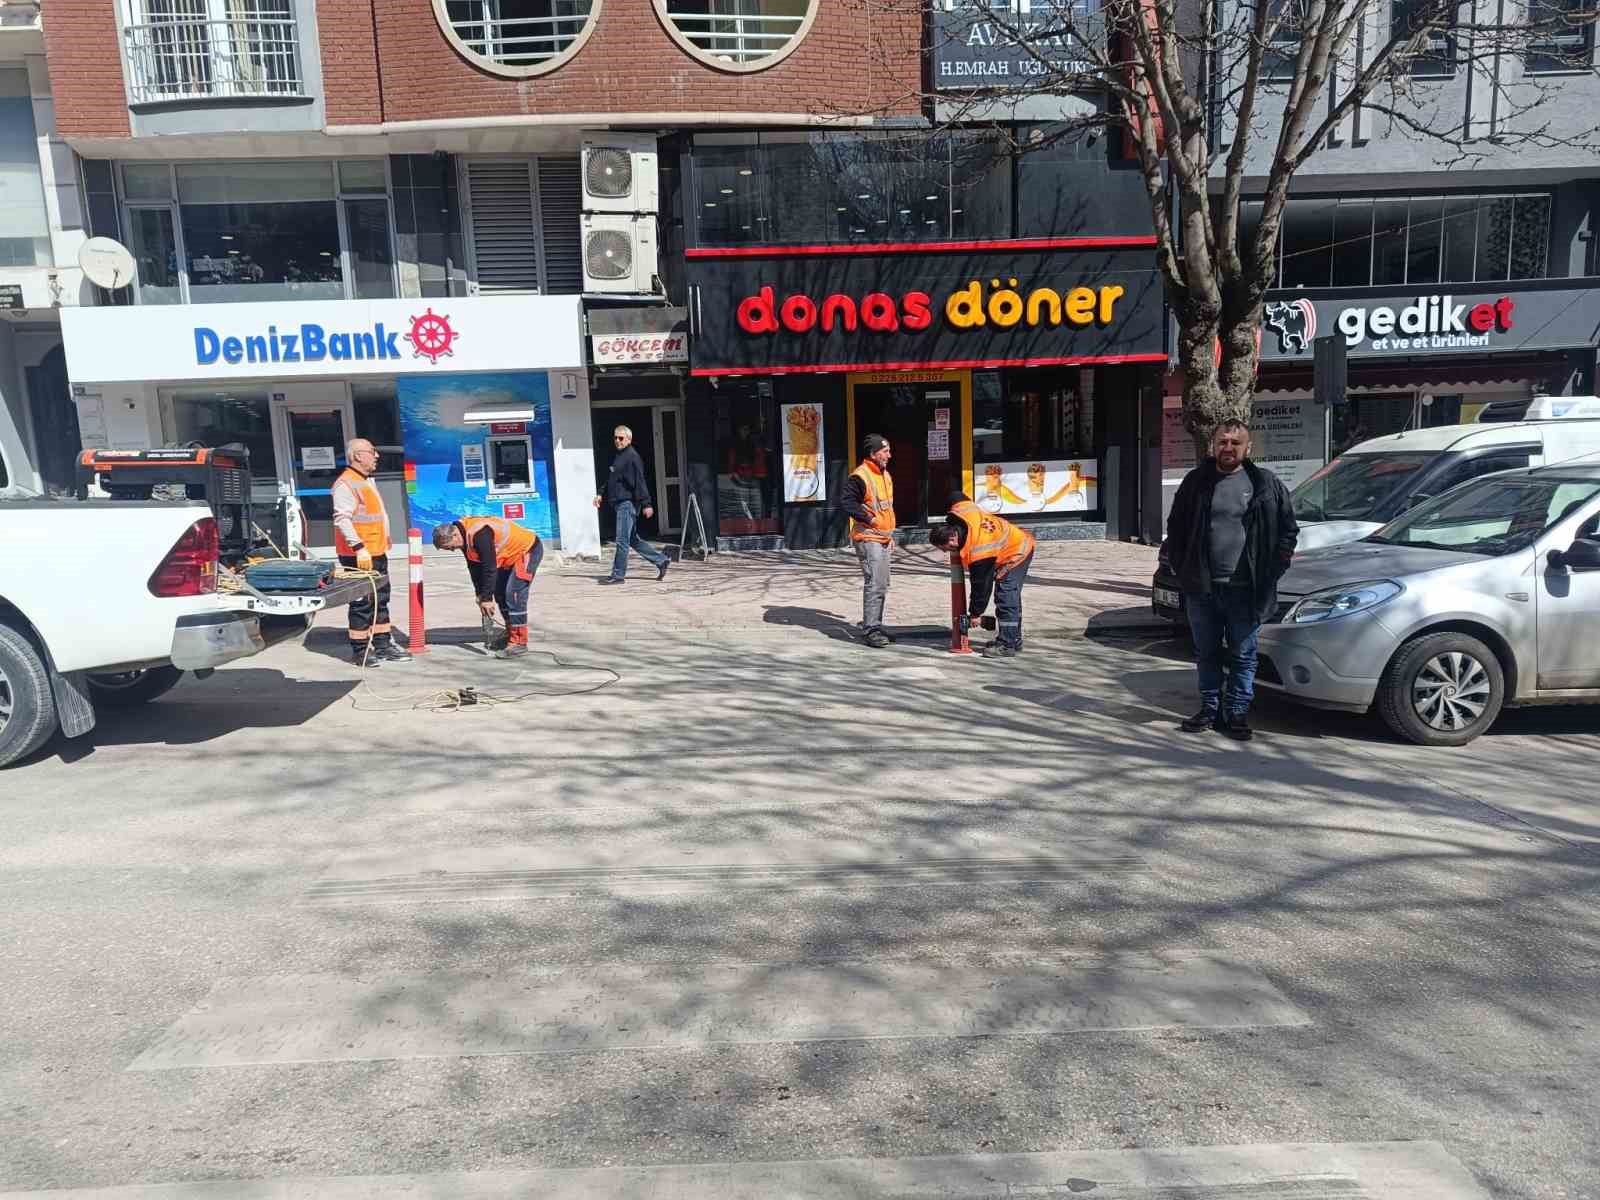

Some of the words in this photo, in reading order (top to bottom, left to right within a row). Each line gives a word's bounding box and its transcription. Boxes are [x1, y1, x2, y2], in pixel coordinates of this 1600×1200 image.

[940, 61, 1009, 76] H.EMRAH
[736, 285, 932, 334] donas
[946, 278, 1124, 328] döner
[1338, 295, 1514, 346] gediket
[193, 322, 401, 365] DenizBank
[1372, 338, 1390, 350] et
[1391, 338, 1409, 350] ve
[1412, 337, 1429, 349] et
[1431, 331, 1489, 348] ürünleri
